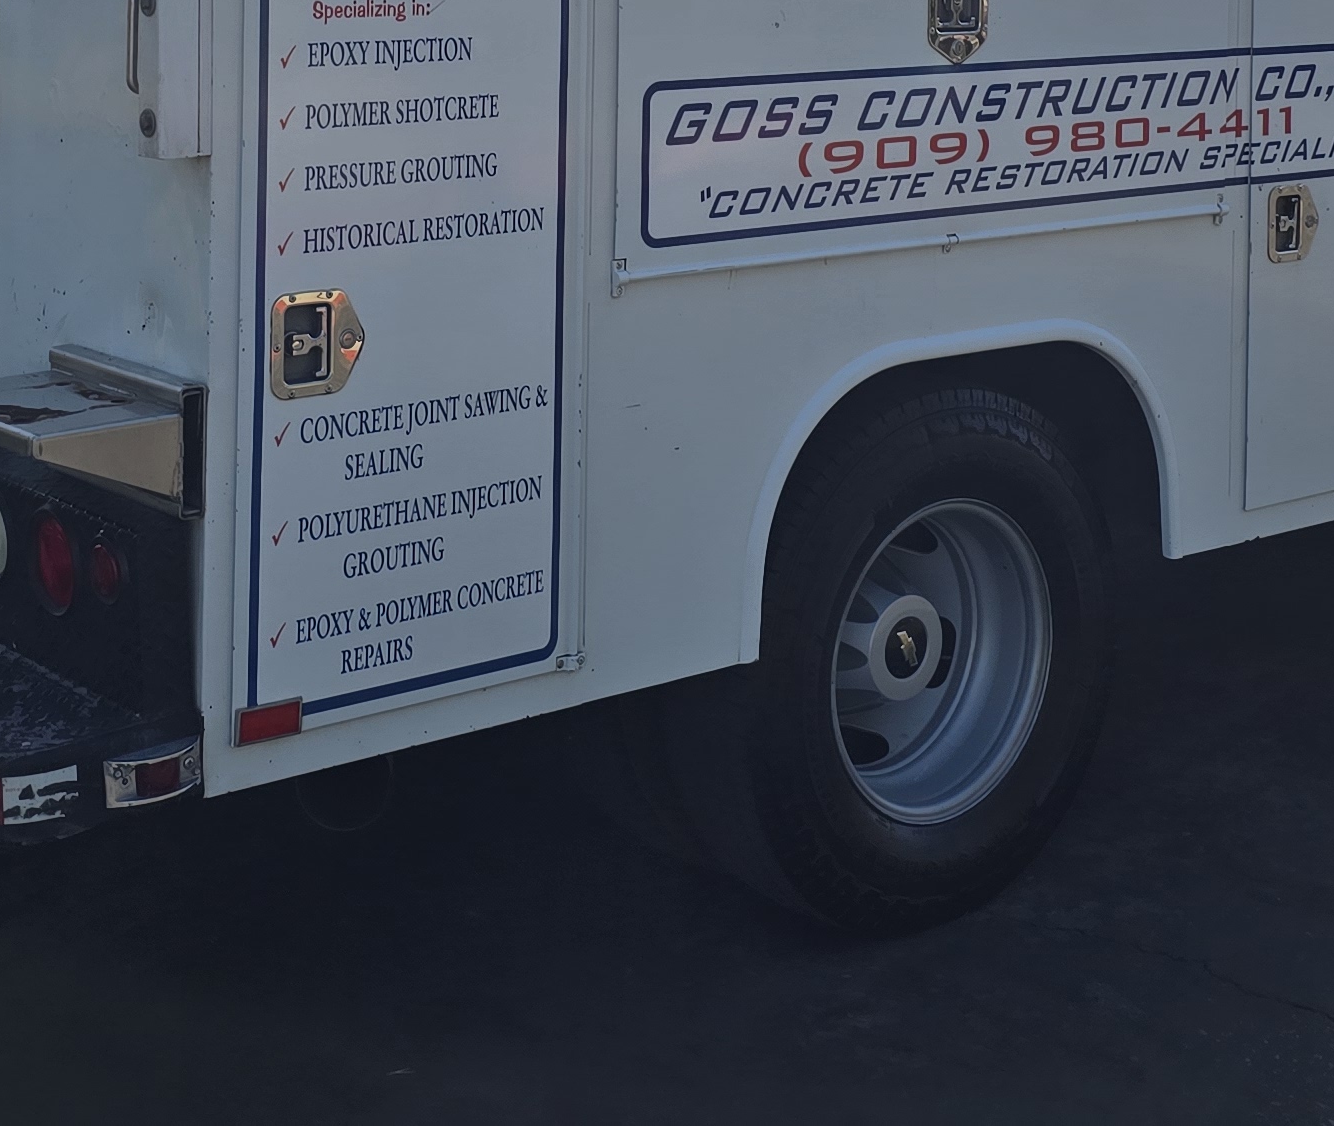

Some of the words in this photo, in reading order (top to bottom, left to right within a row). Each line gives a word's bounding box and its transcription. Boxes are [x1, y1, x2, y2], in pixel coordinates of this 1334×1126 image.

[307, 40, 370, 68] EPOXY
[374, 37, 473, 71] INJECTION
[304, 100, 392, 130] POLYMER
[395, 93, 500, 126] SHOTCRETE
[666, 94, 839, 146] GOSS
[857, 67, 1240, 131] CONSTRUCTION
[798, 129, 990, 177] (909)
[1023, 106, 1293, 157] 980-4411
[304, 160, 397, 192] PRESSURE
[400, 152, 498, 183] GROUTING
[945, 148, 1189, 195] RESTORATION
[303, 219, 419, 254] HISTORICAL
[422, 207, 545, 242] RESTORATION
[300, 404, 404, 444] CONCRETE
[406, 395, 460, 435] JOINT
[464, 385, 531, 419] SAWING
[536, 384, 549, 407] &
[344, 443, 424, 480] SEALING
[297, 493, 448, 543] POLYURETHANE
[451, 475, 543, 518] INJECTION
[343, 536, 445, 579] GROUTING
[296, 608, 355, 645] EPOXY
[358, 608, 372, 630] &
[376, 589, 454, 628] POLYMER
[457, 570, 545, 610] CONCRETE
[340, 636, 414, 675] REPAIRS
